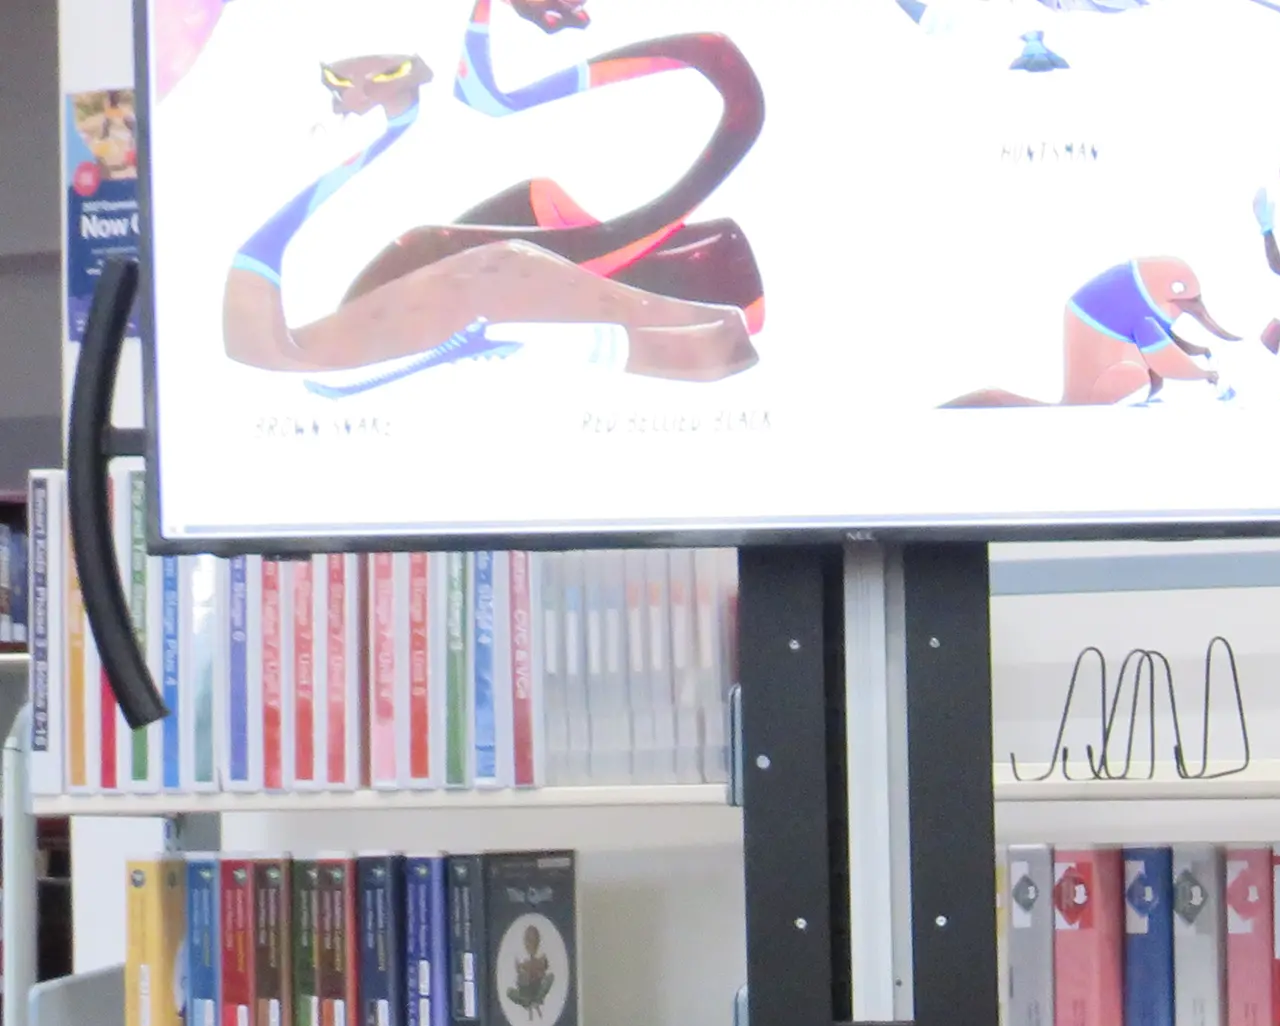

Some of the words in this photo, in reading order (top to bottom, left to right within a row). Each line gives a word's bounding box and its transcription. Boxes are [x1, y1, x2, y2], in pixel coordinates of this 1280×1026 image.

[81, 215, 128, 239] Now
[35, 487, 48, 534] Smart
[132, 480, 147, 504] Pip
[133, 508, 147, 539] and
[35, 586, 48, 635] Phase
[163, 589, 177, 635] Stage
[232, 581, 246, 628] Stage
[165, 638, 177, 673] Plus
